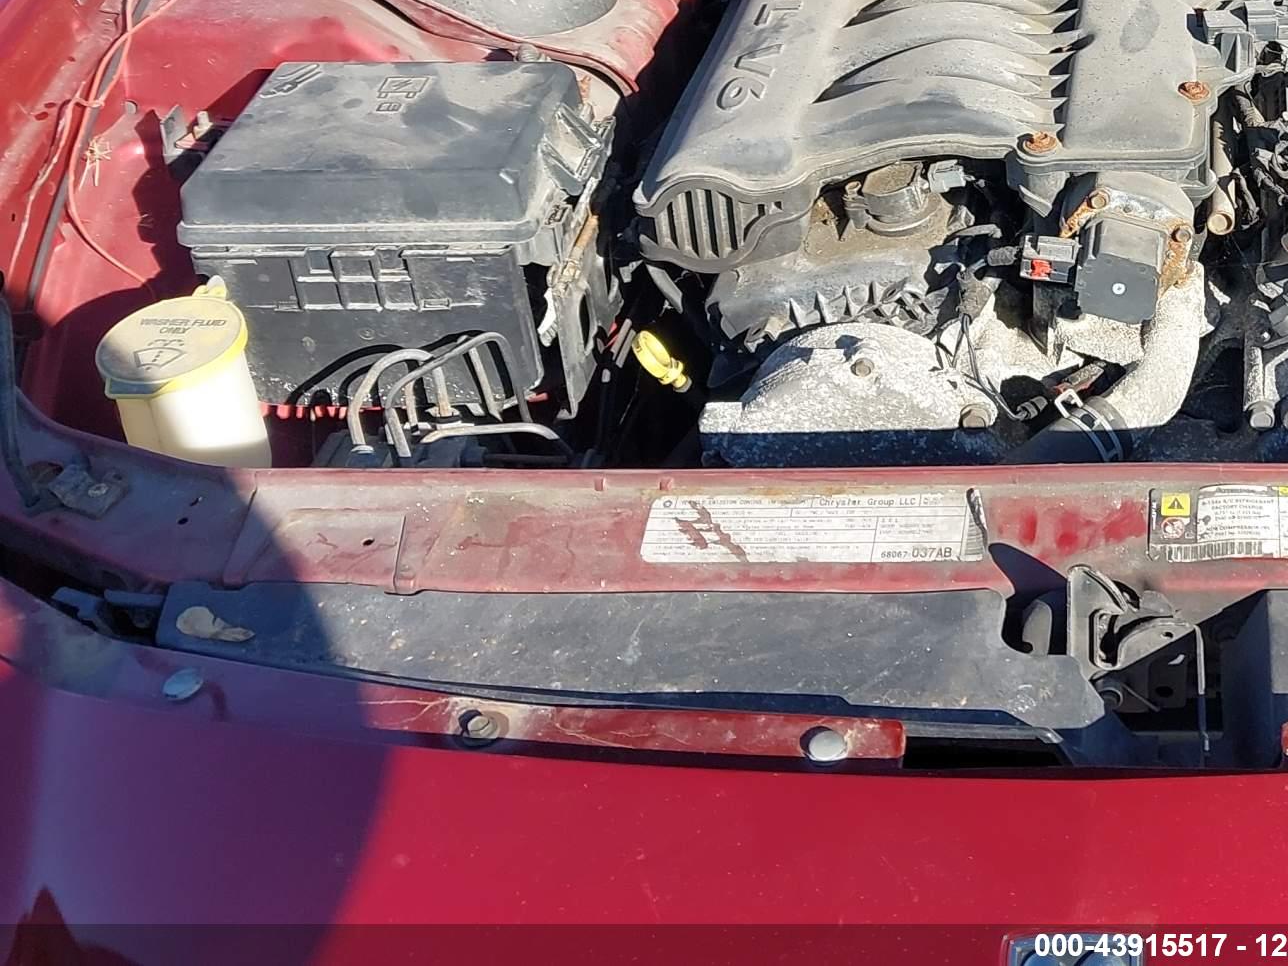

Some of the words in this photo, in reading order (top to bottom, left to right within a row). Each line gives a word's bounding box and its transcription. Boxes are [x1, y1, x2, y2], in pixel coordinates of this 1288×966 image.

[716, 43, 785, 112] V6
[140, 318, 190, 326] WASHER
[159, 326, 191, 334] ONLY
[819, 497, 862, 508] Chrysler
[867, 497, 895, 507] Group
[899, 497, 916, 505] LLC
